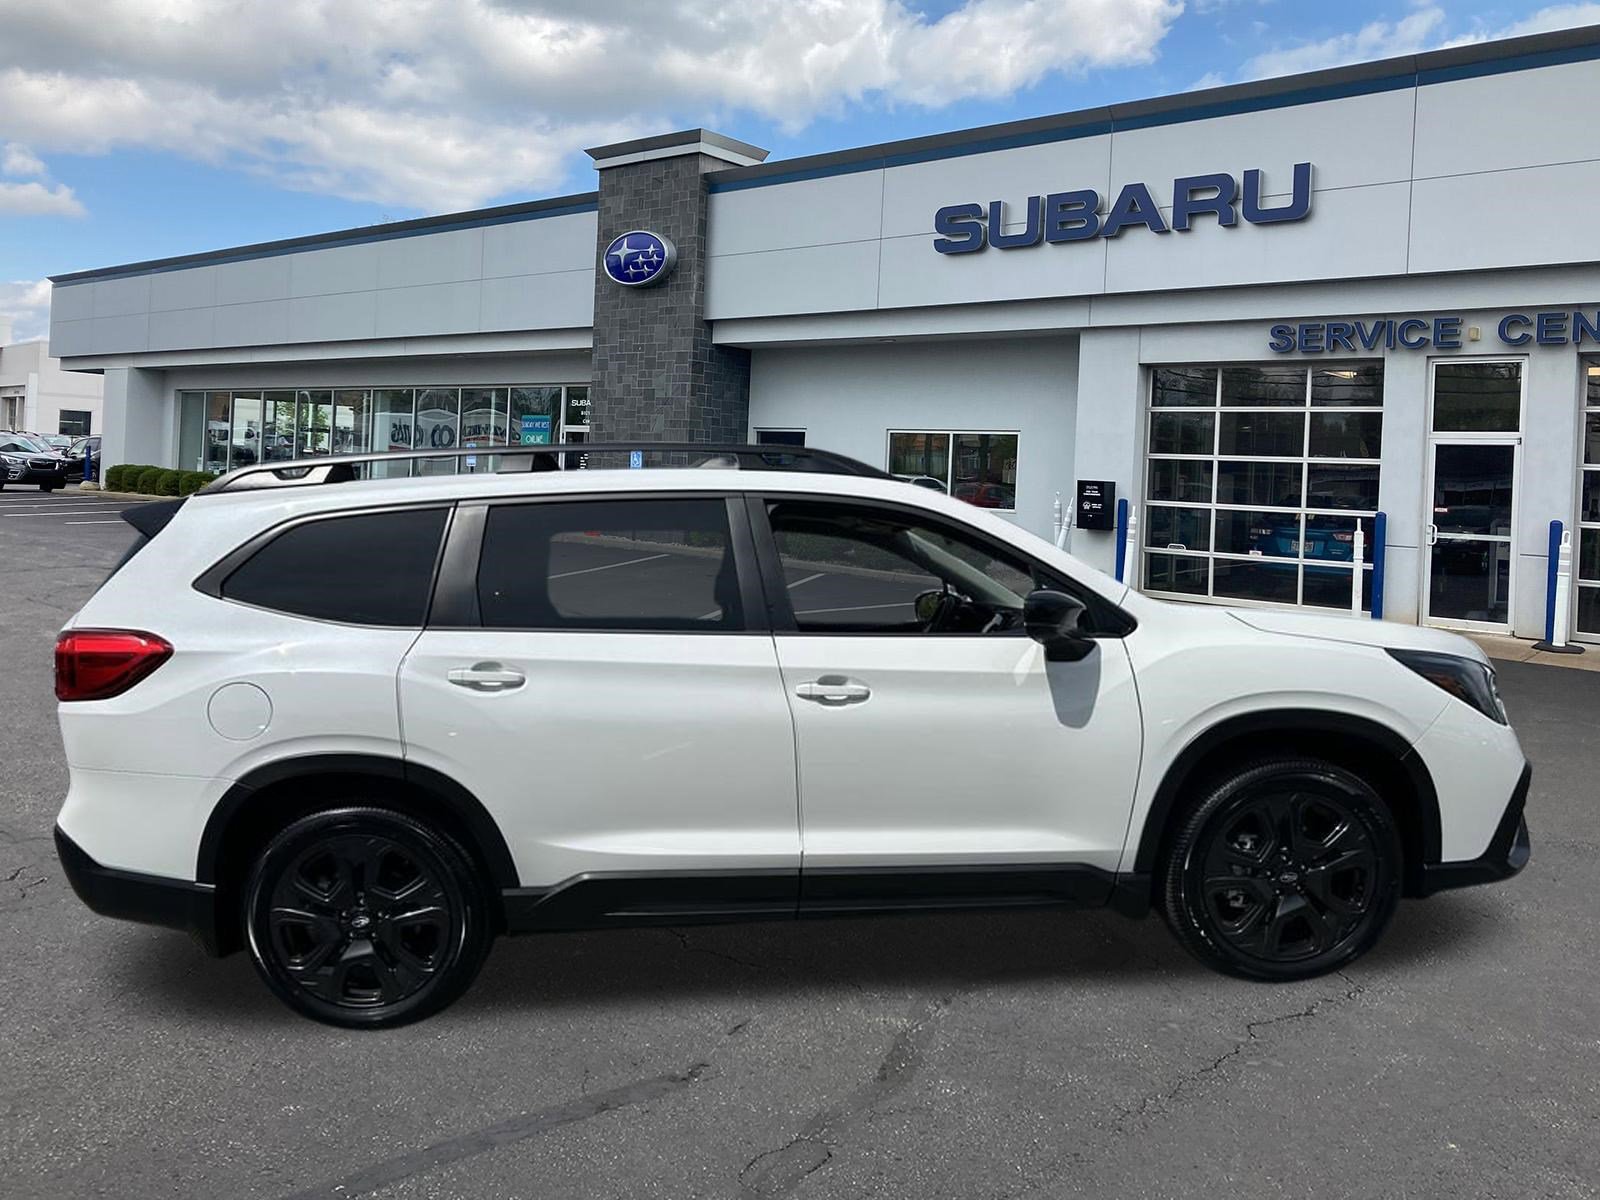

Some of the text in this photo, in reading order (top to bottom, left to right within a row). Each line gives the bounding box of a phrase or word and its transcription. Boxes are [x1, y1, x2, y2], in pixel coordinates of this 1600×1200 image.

[933, 162, 1312, 255] SUBARU
[1269, 310, 1600, 353] SERVICE CEN
